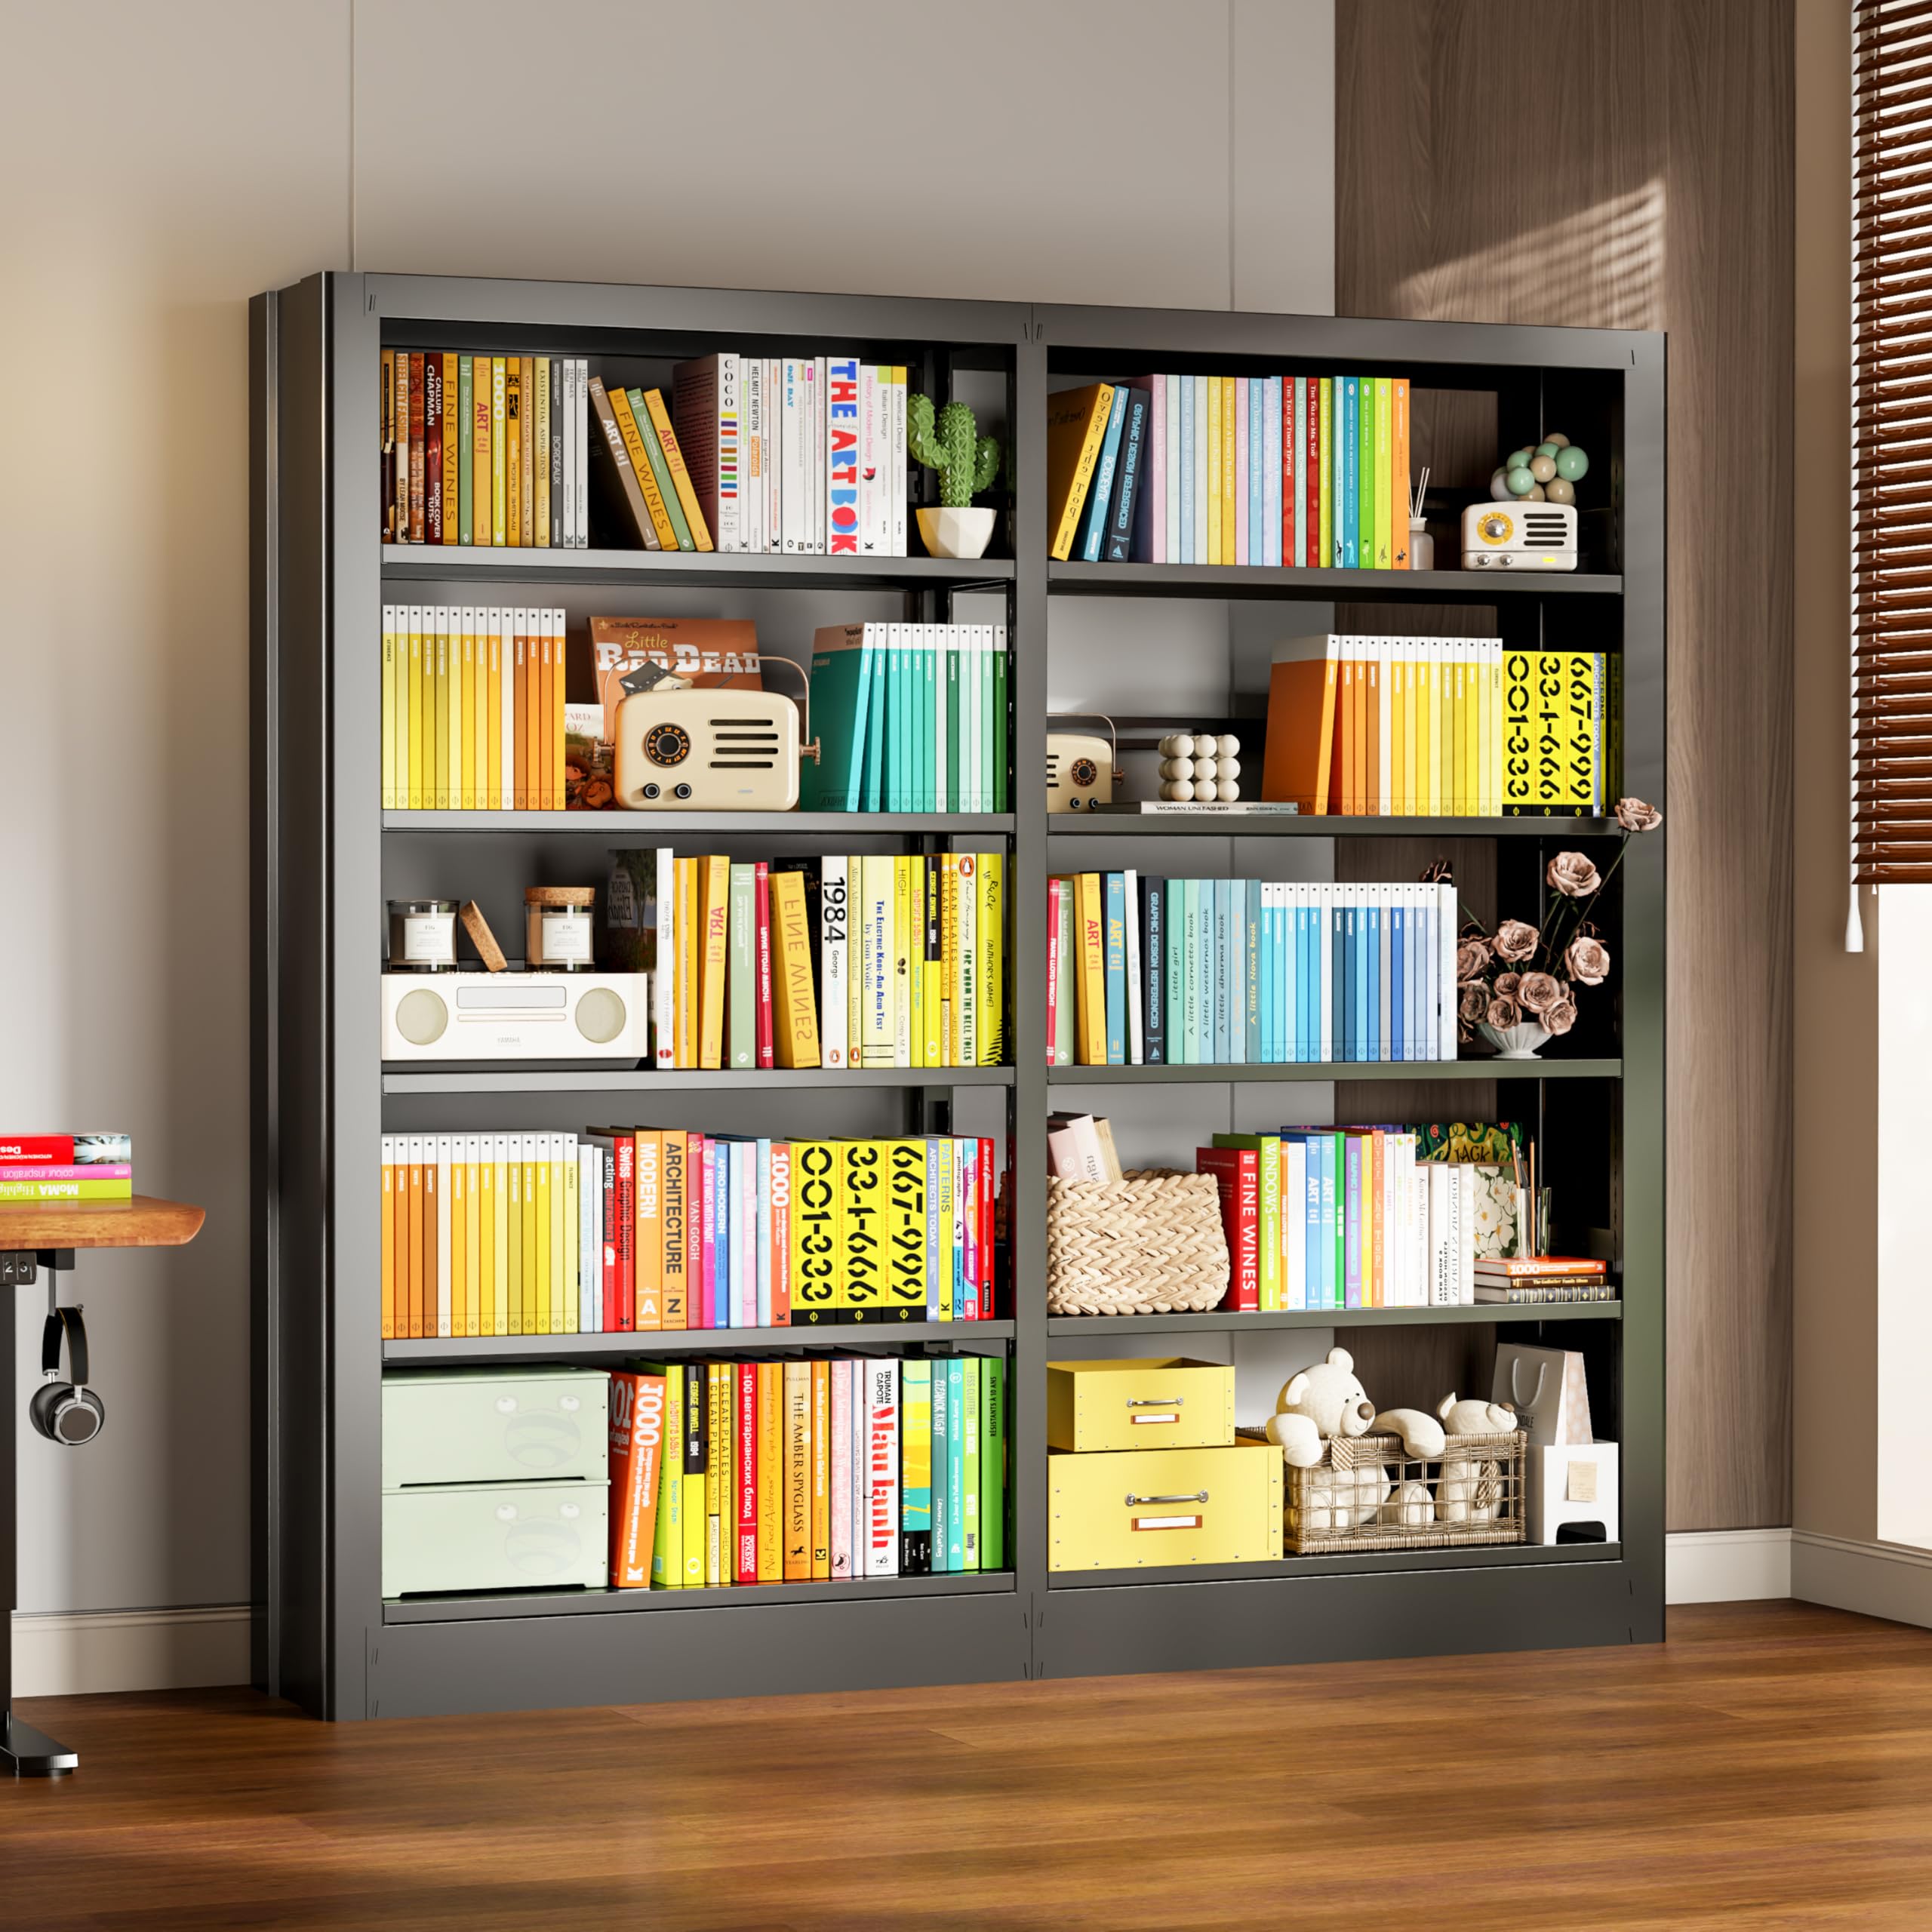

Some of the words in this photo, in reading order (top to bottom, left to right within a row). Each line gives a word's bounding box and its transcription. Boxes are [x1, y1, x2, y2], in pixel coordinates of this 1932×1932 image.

[397, 355, 407, 382] STEEL
[397, 383, 407, 405] CITY
[426, 365, 435, 426] CHAPMAN
[494, 364, 505, 420] 1000
[831, 361, 857, 418] THE
[446, 380, 455, 432] FINE
[476, 402, 488, 432] ART
[397, 405, 407, 443] FASHION
[602, 420, 622, 445] ART
[660, 429, 677, 453] ART
[832, 429, 857, 484] ART
[552, 435, 561, 485] BORDEAUX
[620, 412, 641, 457] FINE
[638, 463, 668, 530] WINES
[446, 444, 455, 521] WINES
[831, 489, 858, 554] BOOK
[625, 631, 668, 649] Little
[673, 645, 760, 674] DEAD
[1508, 655, 1529, 798] 001-333
[1540, 657, 1561, 799] 334-666
[1571, 657, 1592, 799] 667-999
[898, 869, 906, 896] HIGH
[824, 877, 846, 943] 1984
[1150, 892, 1158, 932] GRAPHIC
[864, 924, 872, 936] by
[1088, 919, 1100, 949] ART
[1109, 918, 1122, 949] ART
[831, 950, 839, 978] George
[963, 949, 972, 966] FOR
[1150, 934, 1158, 968] DESIGN
[963, 968, 972, 994] WHOM
[963, 998, 972, 1012] THE
[1150, 970, 1158, 1029] REFERENCED
[963, 1015, 972, 1034] BELL
[1250, 1015, 1257, 1025] A
[963, 1036, 972, 1060] TOLLS
[3, 1168, 45, 1179] inspiration
[50, 1169, 73, 1177] colour
[603, 1156, 615, 1189] acting
[619, 1146, 633, 1177] Swiss
[704, 1169, 713, 1183] NEW
[718, 1158, 726, 1186] AFRO
[39, 1184, 78, 1195] MoMA
[640, 1143, 657, 1218] MODERN
[704, 1184, 713, 1203] WAYS
[771, 1152, 789, 1207] 1000
[941, 1143, 950, 1213] PATTERNS
[1264, 1142, 1277, 1214] WINDOWS
[1308, 1177, 1318, 1204] ART
[1322, 1177, 1333, 1204] ART
[617, 1181, 632, 1223] Graphic
[666, 1143, 681, 1274] ARCHITECTURE
[1243, 1173, 1255, 1216] FINE
[691, 1200, 700, 1223] VAN
[704, 1204, 713, 1222] WITH
[718, 1189, 726, 1233] MODERN
[801, 1146, 832, 1302] 001-333
[847, 1146, 878, 1302] 334-666
[892, 1146, 923, 1300] 667-999
[617, 1225, 632, 1260] Design
[691, 1227, 700, 1260] GOGH
[704, 1223, 713, 1244] PAINT
[5, 1262, 13, 1272] 2
[1242, 1225, 1256, 1290] WINES
[1509, 1264, 1540, 1275] 1000
[640, 1299, 657, 1315] A
[667, 1299, 681, 1313] Z
[690, 1381, 699, 1406] GEORGE
[743, 1374, 752, 1393] 100
[934, 1380, 945, 1412] ELEANOR
[690, 1407, 699, 1433] ORWELL
[709, 1386, 718, 1425] CLEAN
[793, 1393, 804, 1420] THE
[743, 1396, 752, 1485] вегетарианских
[872, 1405, 896, 1472] Máu
[934, 1414, 945, 1436] RIGBY
[690, 1441, 699, 1456] 1984
[709, 1432, 718, 1478] PLATES
[793, 1423, 804, 1468] AMBER
[743, 1488, 754, 1518] блюд
[793, 1472, 804, 1533] SPYGLASS
[872, 1479, 894, 1549] lanh
[744, 1535, 752, 1573] КУКБУКС
